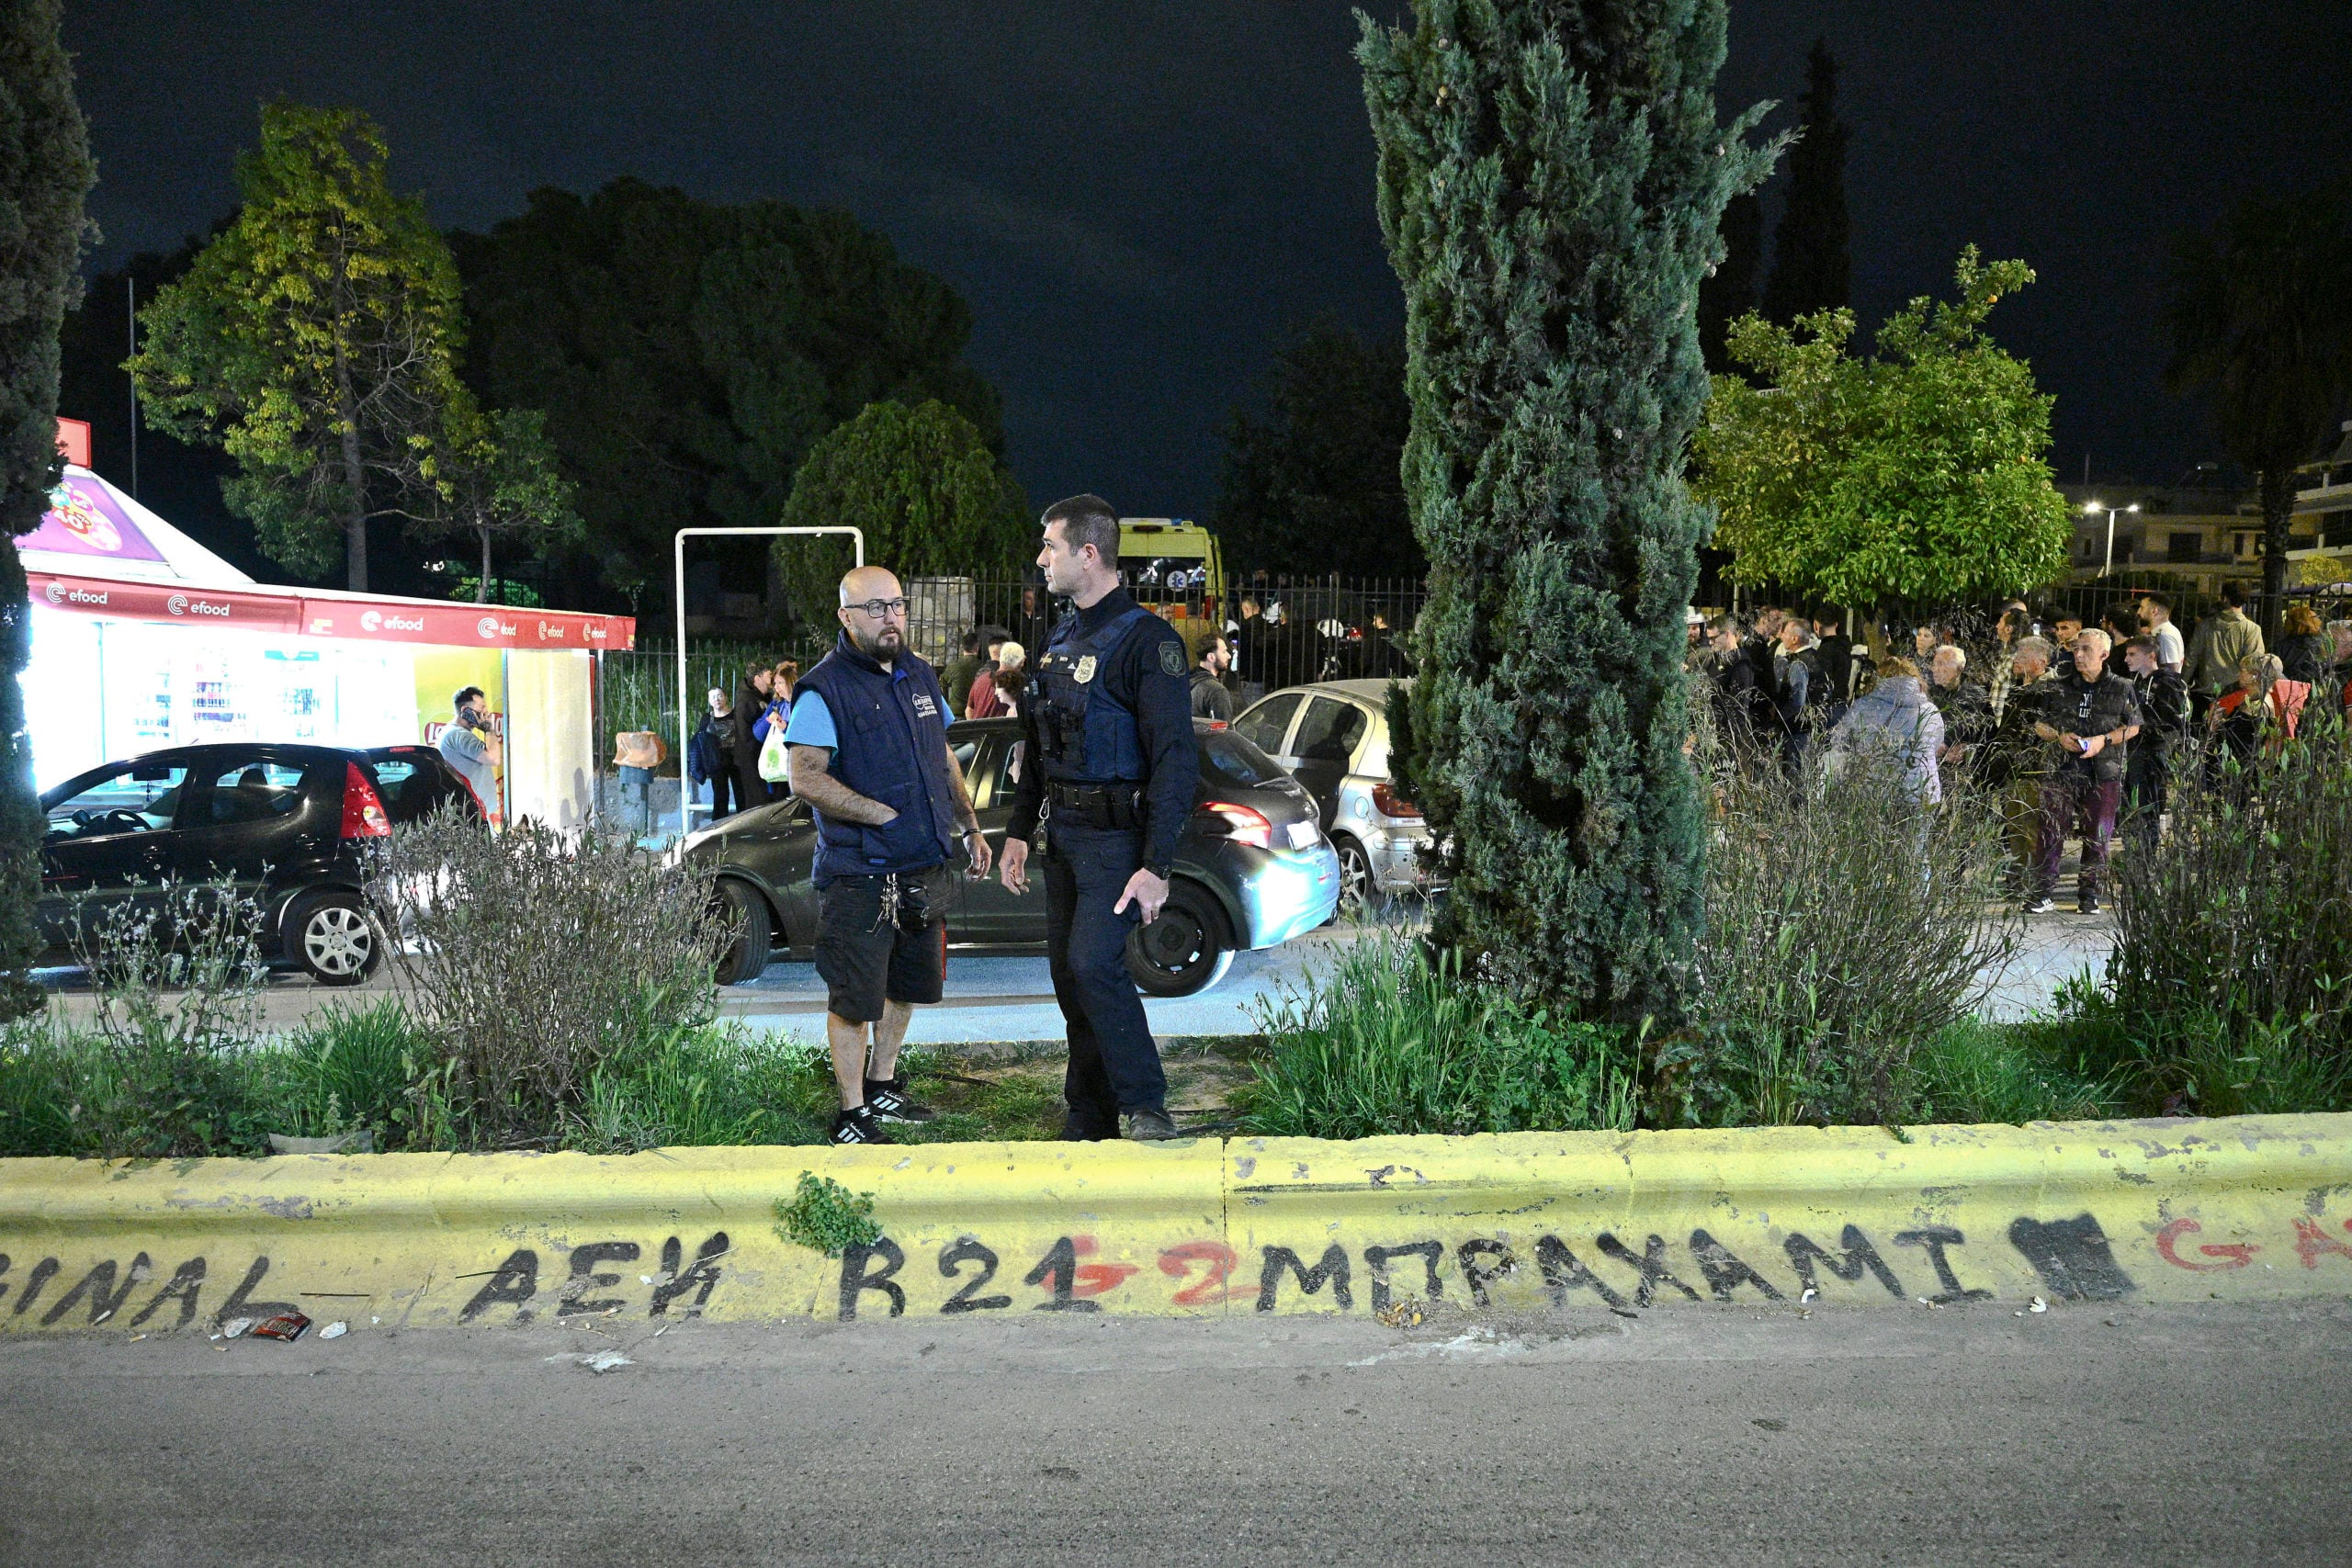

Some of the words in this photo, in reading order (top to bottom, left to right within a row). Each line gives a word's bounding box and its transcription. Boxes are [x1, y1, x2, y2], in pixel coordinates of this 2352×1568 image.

[69, 589, 108, 604] efood
[190, 602, 231, 616] efood
[383, 615, 424, 631] efood
